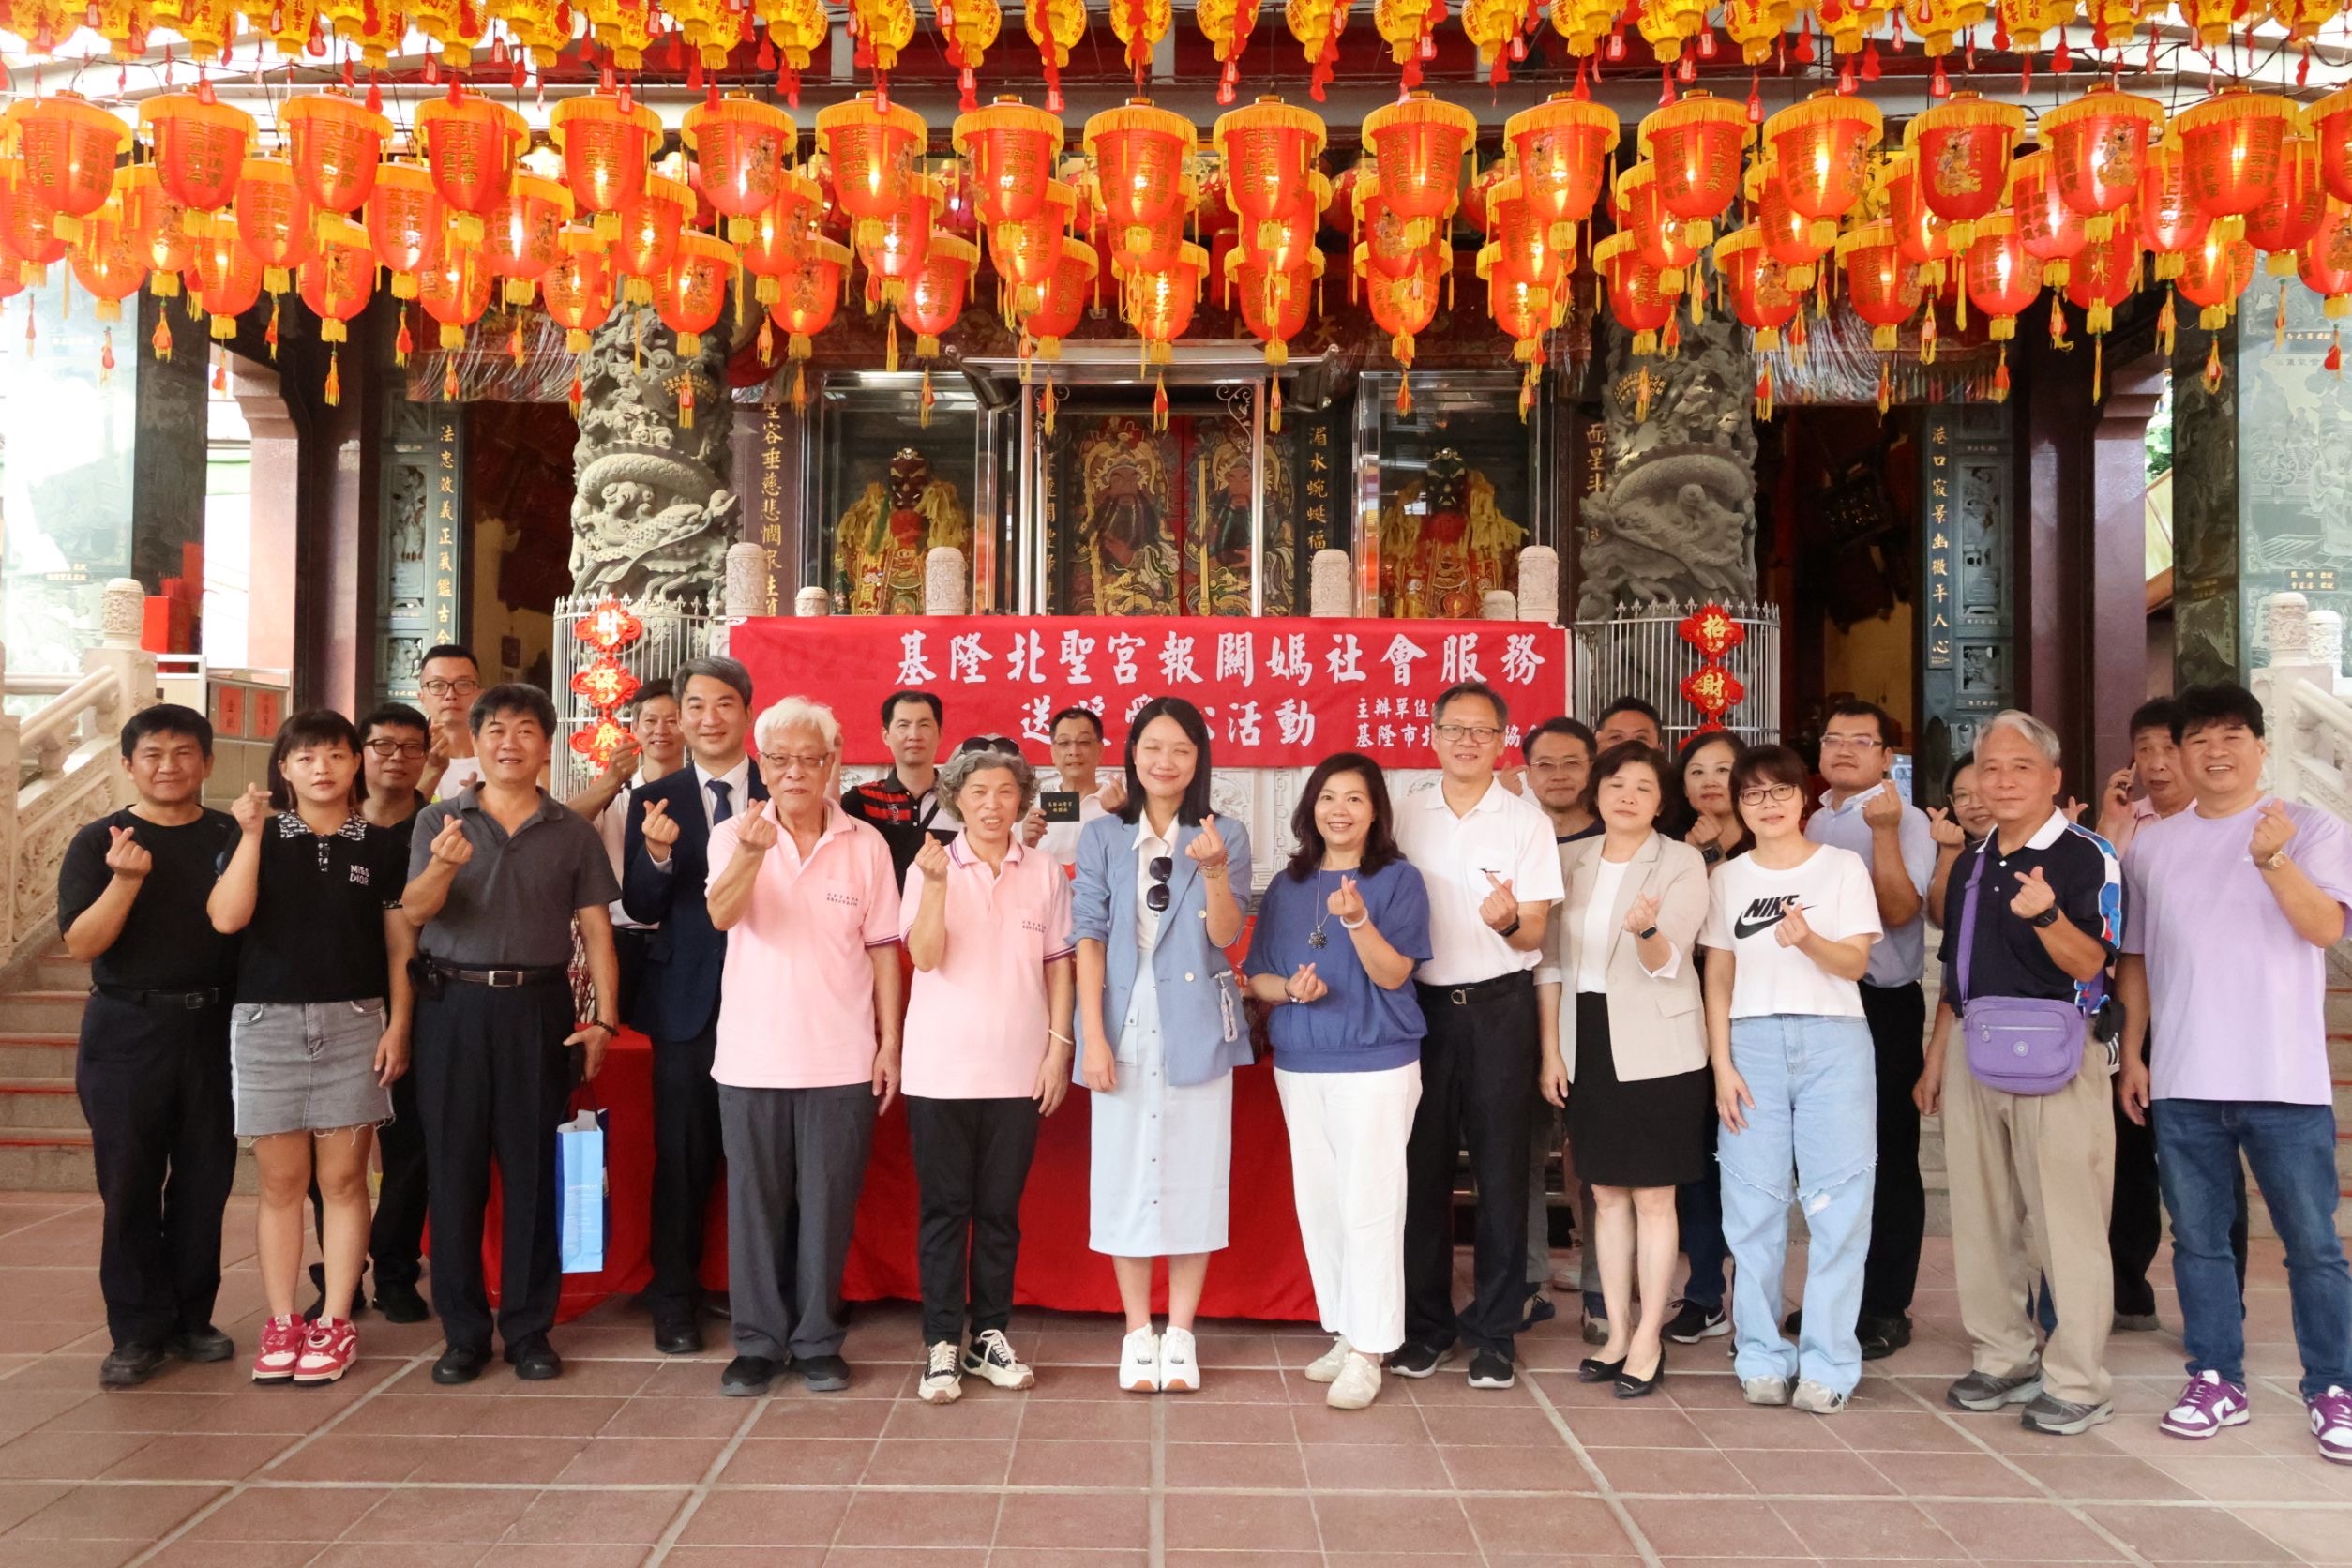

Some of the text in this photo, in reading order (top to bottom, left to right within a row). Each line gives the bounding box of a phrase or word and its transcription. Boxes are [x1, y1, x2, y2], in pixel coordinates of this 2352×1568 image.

[896, 629, 1546, 686] 基隆北聖宮報關媽社會服務
